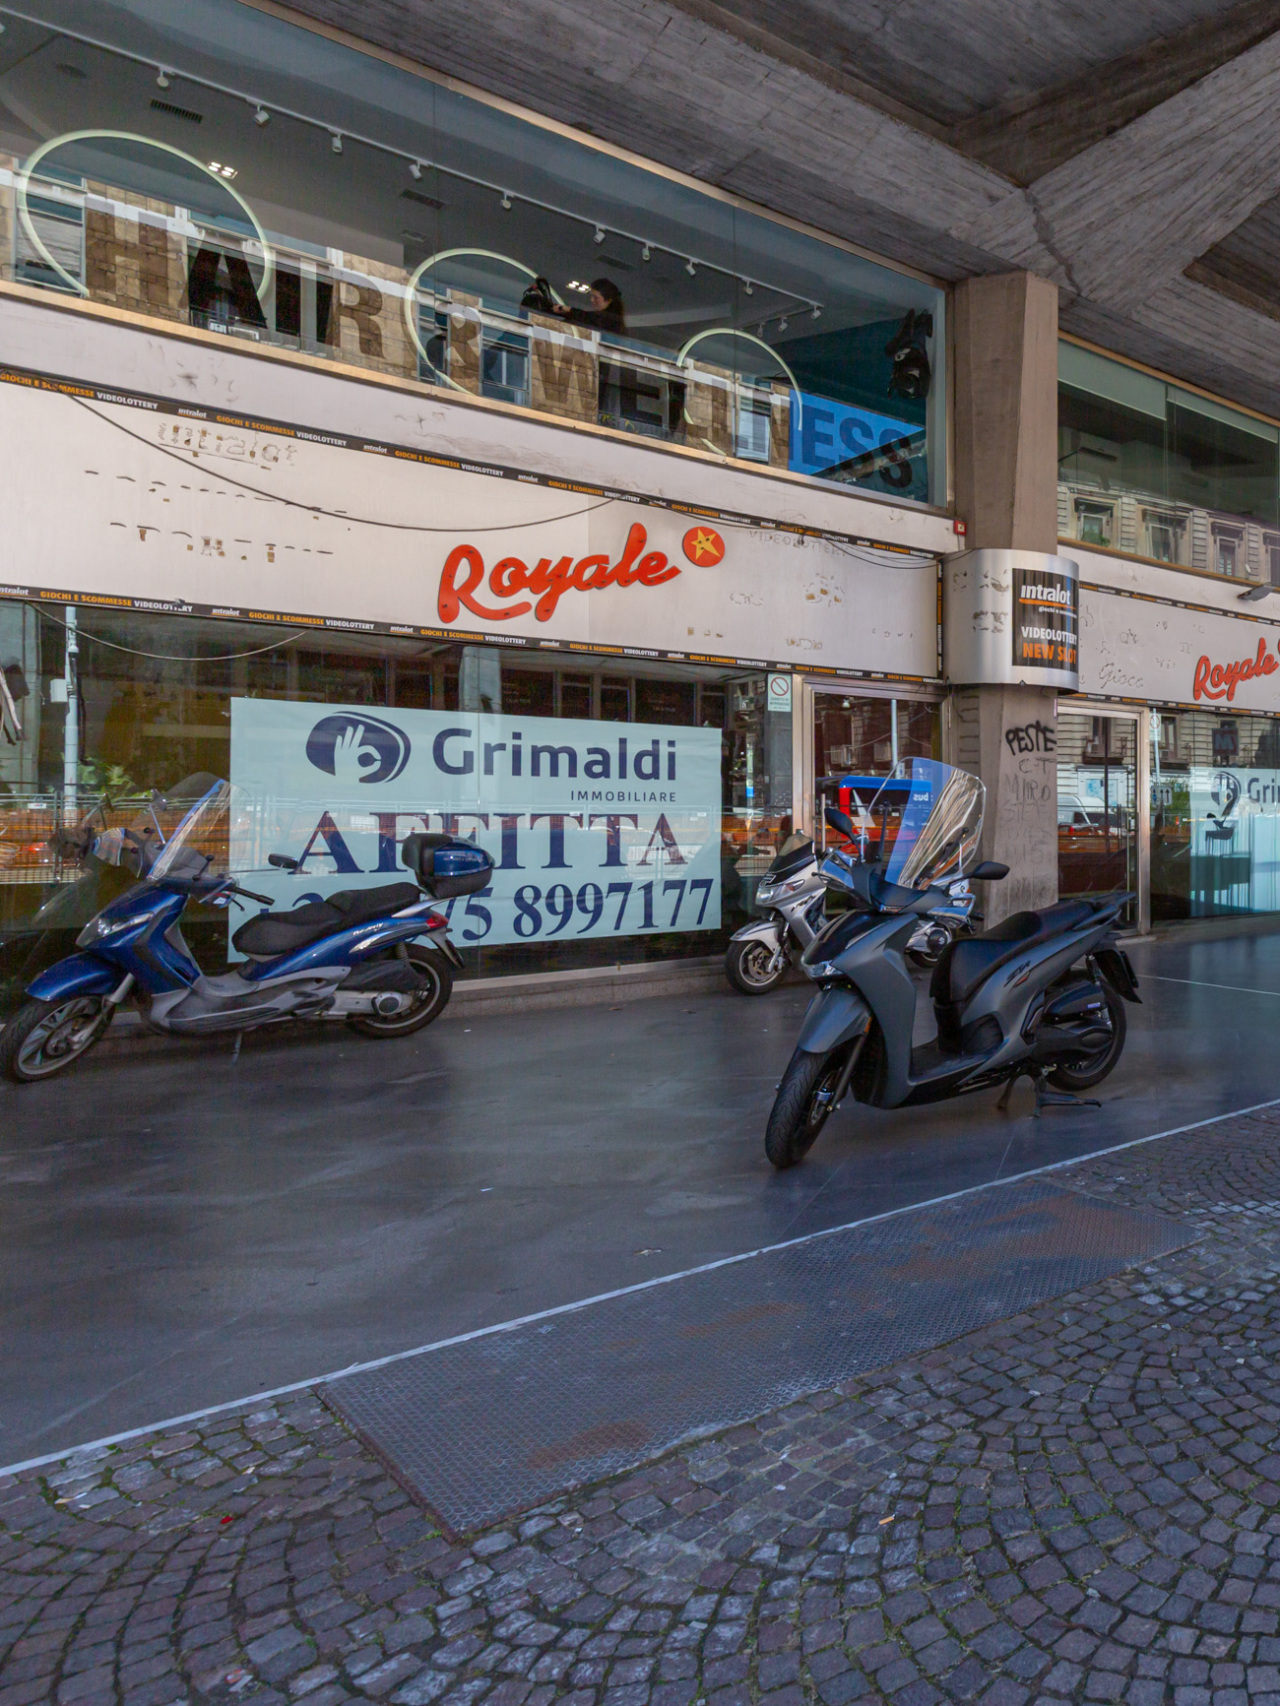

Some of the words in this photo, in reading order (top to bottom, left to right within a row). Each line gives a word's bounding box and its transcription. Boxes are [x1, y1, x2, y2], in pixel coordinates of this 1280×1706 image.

[0, 373, 32, 386] GIOCHI
[42, 381, 95, 398] SCOMMESSE
[97, 392, 158, 410] VIDEOLOTTERY
[216, 415, 244, 427] GIOCHI
[252, 422, 295, 437] SCOMMESSE
[296, 430, 348, 447] VIDEOLOTTERY
[395, 451, 417, 461] GIOCHI
[424, 456, 460, 469] SCOMMESSE
[461, 463, 504, 477] VIDEOLOTTERY
[437, 522, 682, 623] Royale
[0, 587, 29, 596] ntralot
[40, 591, 72, 601] GIOCHI
[81, 595, 132, 607] SCOMMESSE
[249, 612, 275, 620] GIOCHI
[282, 615, 324, 625] SCOMMESSE
[325, 619, 375, 630] VIDEOLOTTERY
[1020, 625, 1077, 645] VIDEOLOTTERY
[420, 629, 442, 637] GIOCHI
[449, 631, 484, 641] SCOMMESSE
[485, 635, 526, 645] VIDEOLOTTERY
[1022, 642, 1055, 660] NEW
[1057, 645, 1077, 664] SLOT
[1193, 637, 1280, 701] Royale
[1005, 720, 1057, 756] PESTE
[431, 727, 677, 782] Grimaldi
[570, 790, 677, 803] IMMOBILIARE
[512, 878, 714, 938] 8997177
